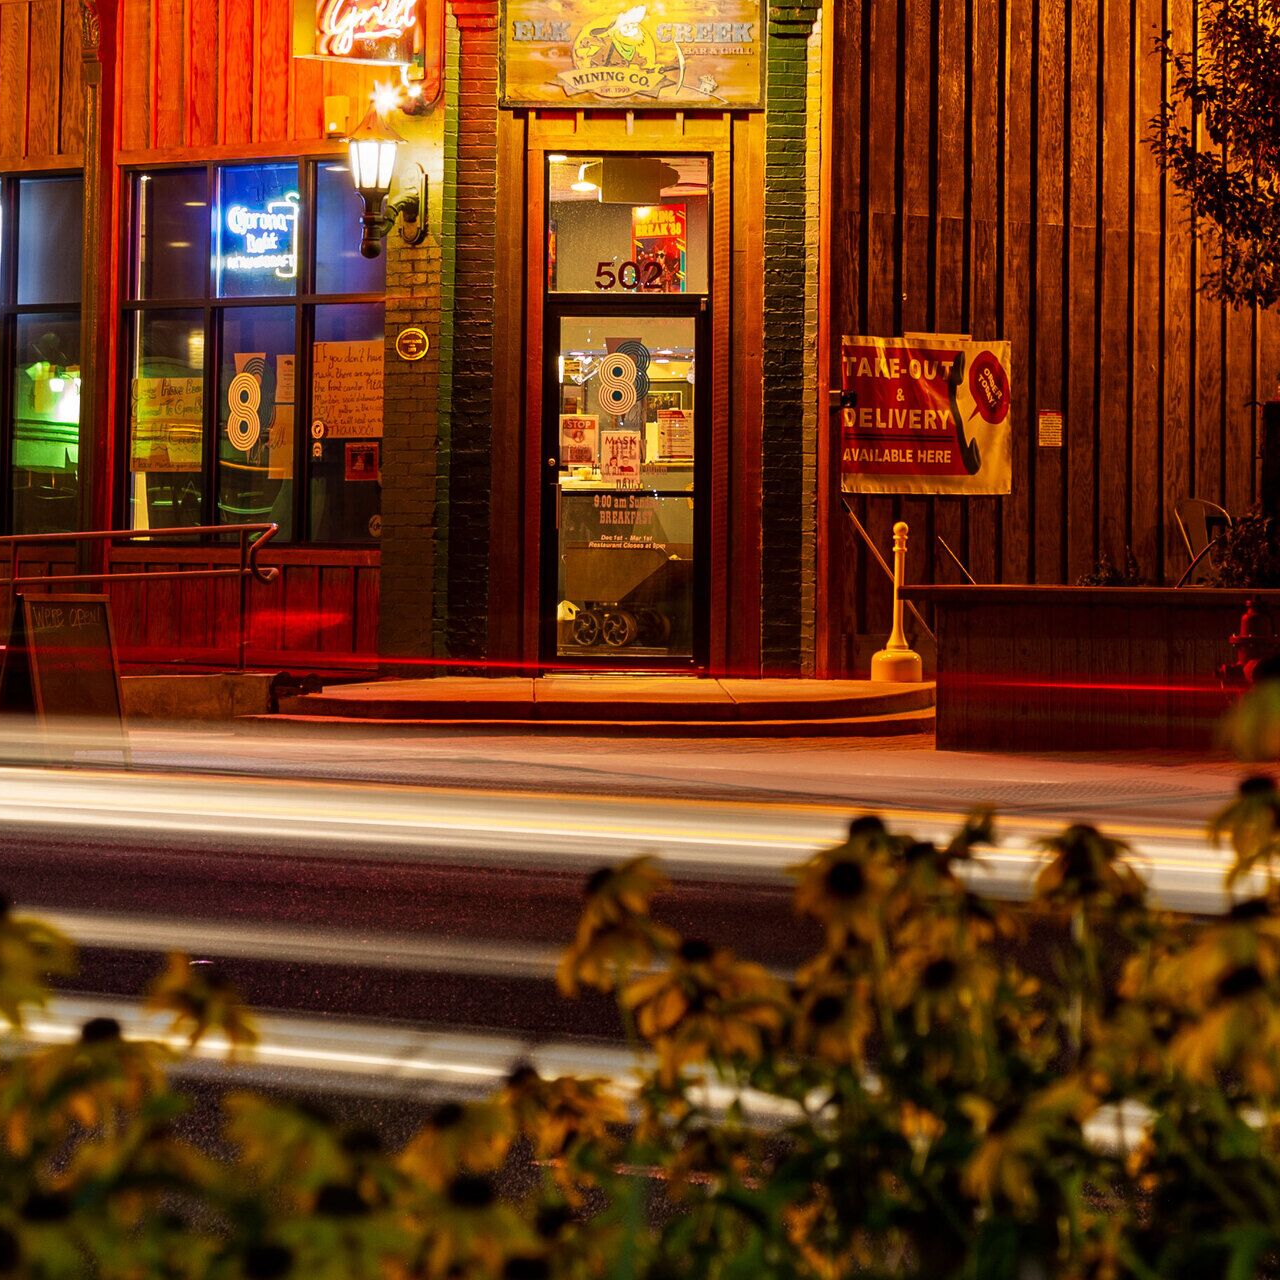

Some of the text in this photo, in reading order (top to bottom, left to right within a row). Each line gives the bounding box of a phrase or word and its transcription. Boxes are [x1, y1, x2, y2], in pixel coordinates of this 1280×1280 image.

[512, 20, 754, 43] ELK CREEK
[684, 47, 755, 56] BAR & GRILL
[572, 71, 650, 88] MINING CO.
[227, 206, 289, 235] Corona
[635, 223, 669, 238] BREAK
[594, 260, 664, 290] 502
[842, 356, 955, 381] TAKE-OUT
[976, 373, 998, 409] TODAY!
[982, 367, 1004, 401] ORDER
[895, 388, 906, 403] &
[567, 421, 592, 429] STOP
[842, 406, 952, 431] DELIVERY
[605, 436, 637, 446] MASK
[842, 447, 953, 465] AVAILABLE HERE
[613, 498, 627, 508] am
[599, 510, 653, 525] BREAKFAST
[588, 541, 623, 549] Restaurant
[623, 541, 644, 549] Closes
